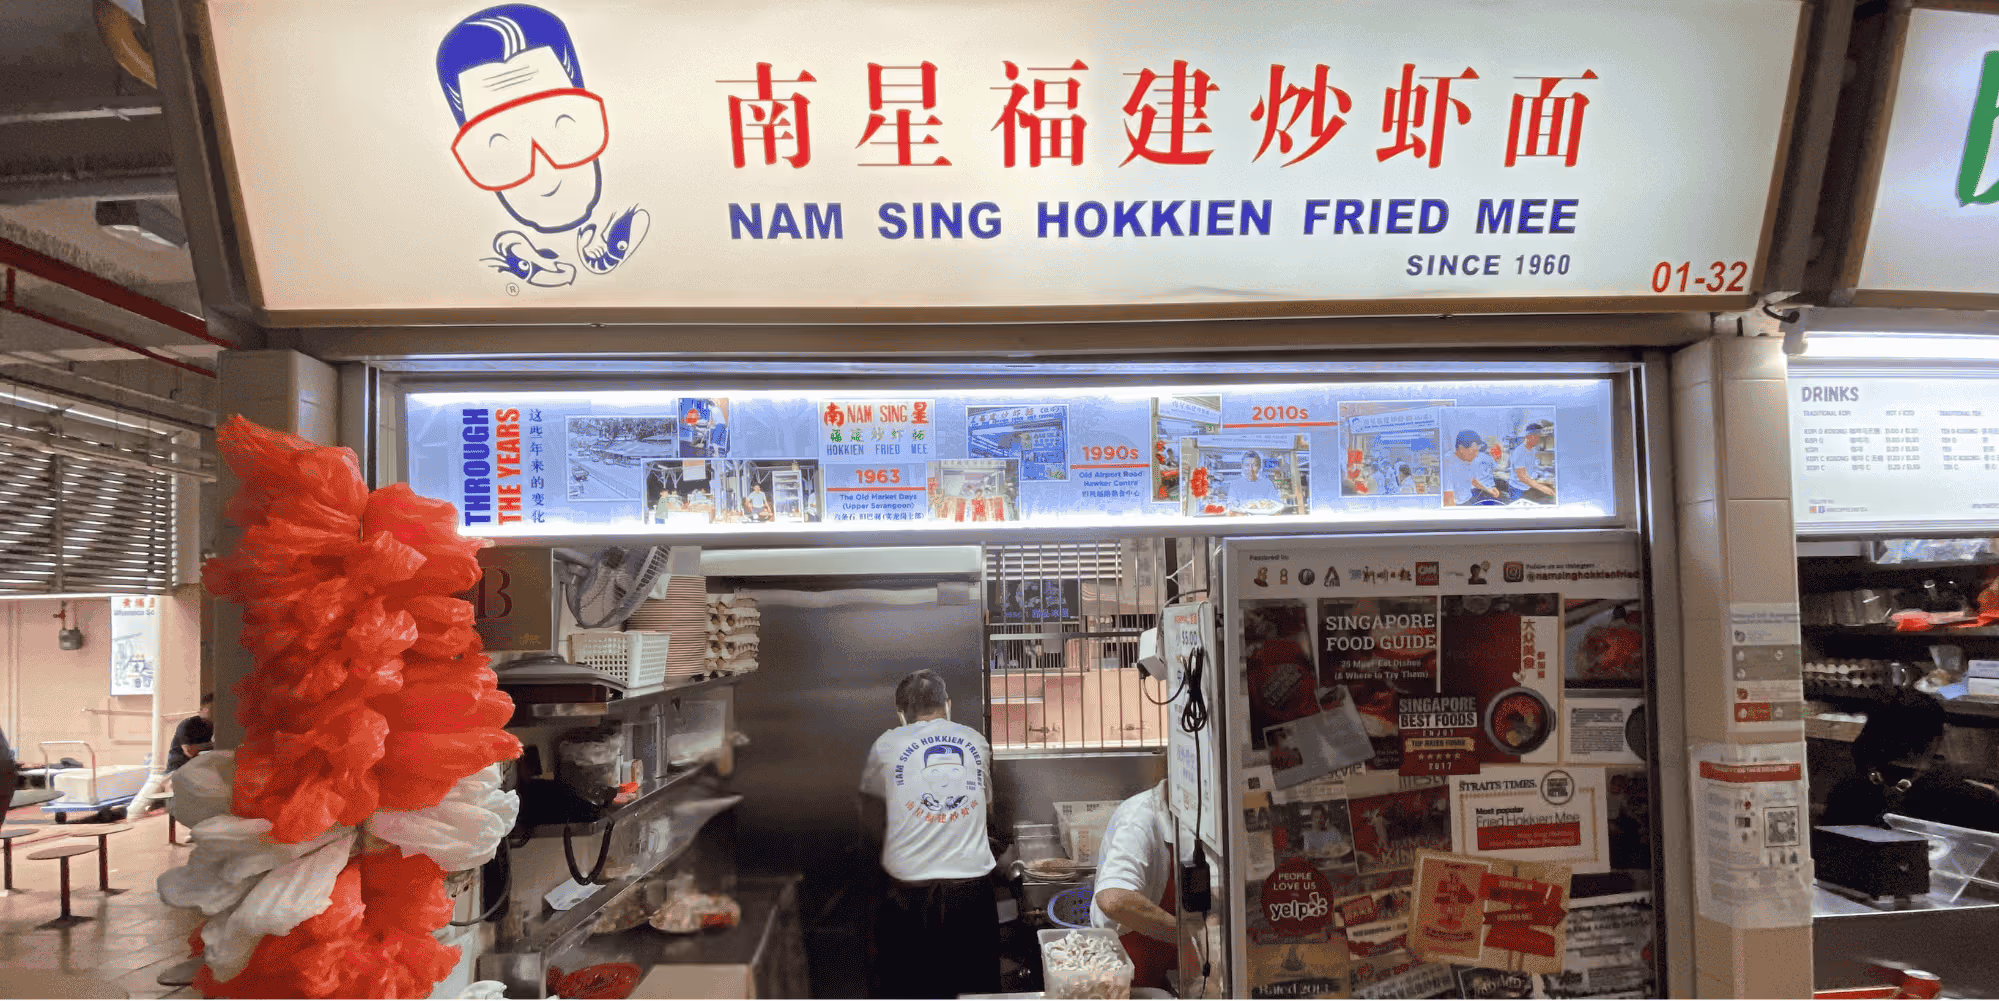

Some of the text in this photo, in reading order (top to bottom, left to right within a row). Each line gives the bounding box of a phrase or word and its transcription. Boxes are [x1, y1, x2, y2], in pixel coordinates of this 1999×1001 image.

[715, 59, 1599, 169] 南星福建炒虾面
[728, 198, 1579, 240] NAM SING HOKKIEN FRIED MEE
[1405, 253, 1571, 277] SINCE 1960
[1651, 261, 1748, 294] 01-32
[1801, 386, 1859, 402] DRINKS
[847, 404, 909, 424] NAM SING
[1252, 405, 1309, 421] 2010s
[827, 443, 929, 456] HOKKIEN FRIED MEE
[1082, 445, 1139, 461] 1990s
[463, 409, 491, 526] THROUGH
[495, 408, 522, 525] THE YEARS
[529, 408, 545, 523] 这些年来的变化
[855, 468, 901, 484] 1963
[1094, 471, 1121, 479] Airport
[840, 493, 853, 501] The
[855, 493, 869, 501] Old
[898, 493, 917, 501] Days
[842, 502, 915, 510] (Upper Serangoon)
[1326, 614, 1435, 631] SINGAPORE
[1326, 634, 1436, 652] FOOD GUIDE
[1345, 671, 1372, 679] Where
[1385, 671, 1399, 680] Try
[1402, 669, 1429, 679] Them)
[1400, 697, 1477, 713] SINGAPORE
[1401, 712, 1475, 727] BEST FOODS
[920, 736, 964, 746] HOKKIEN
[900, 742, 920, 762] SING
[965, 742, 982, 766] FRIED
[1428, 762, 1452, 771] 2017
[896, 765, 905, 786] NAM
[1459, 780, 1501, 791] STRAITS
[1496, 807, 1524, 816] popular
[1476, 812, 1580, 828] Fried Hokkien Mee
[1278, 872, 1312, 880] PEOPLE
[1273, 882, 1316, 891] LOVE US
[1269, 900, 1310, 922] yelp
[1258, 983, 1297, 995] Rated
